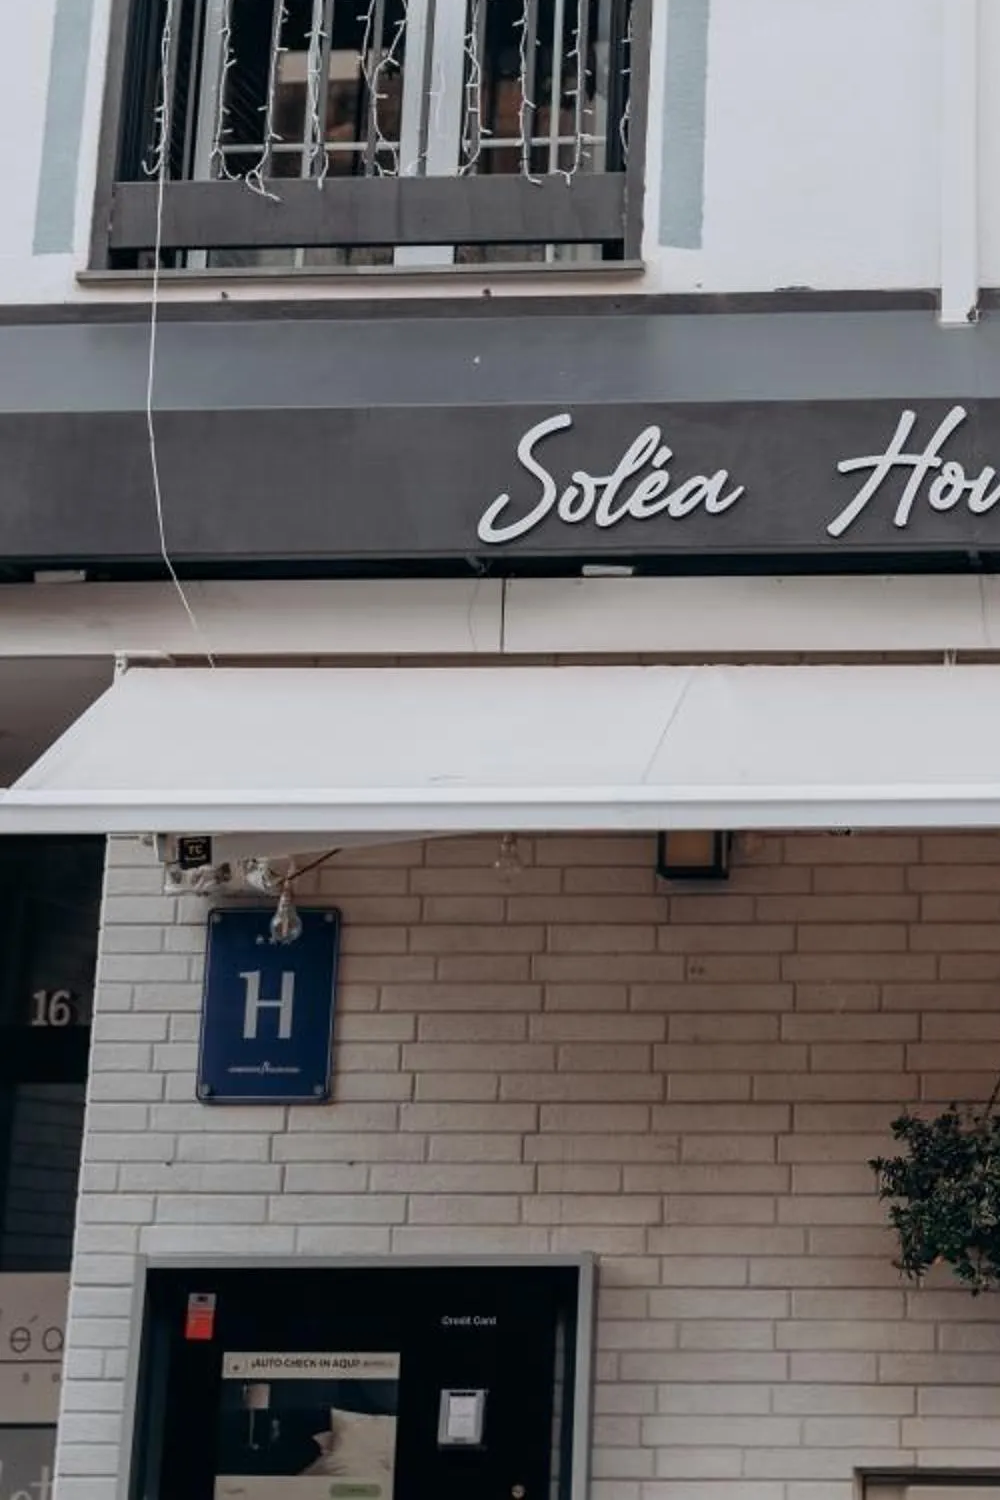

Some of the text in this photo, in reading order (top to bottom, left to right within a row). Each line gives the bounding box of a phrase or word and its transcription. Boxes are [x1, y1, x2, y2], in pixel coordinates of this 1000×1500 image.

[477, 412, 746, 543] Soléa
[31, 989, 71, 1027] 16
[239, 970, 296, 1040] H
